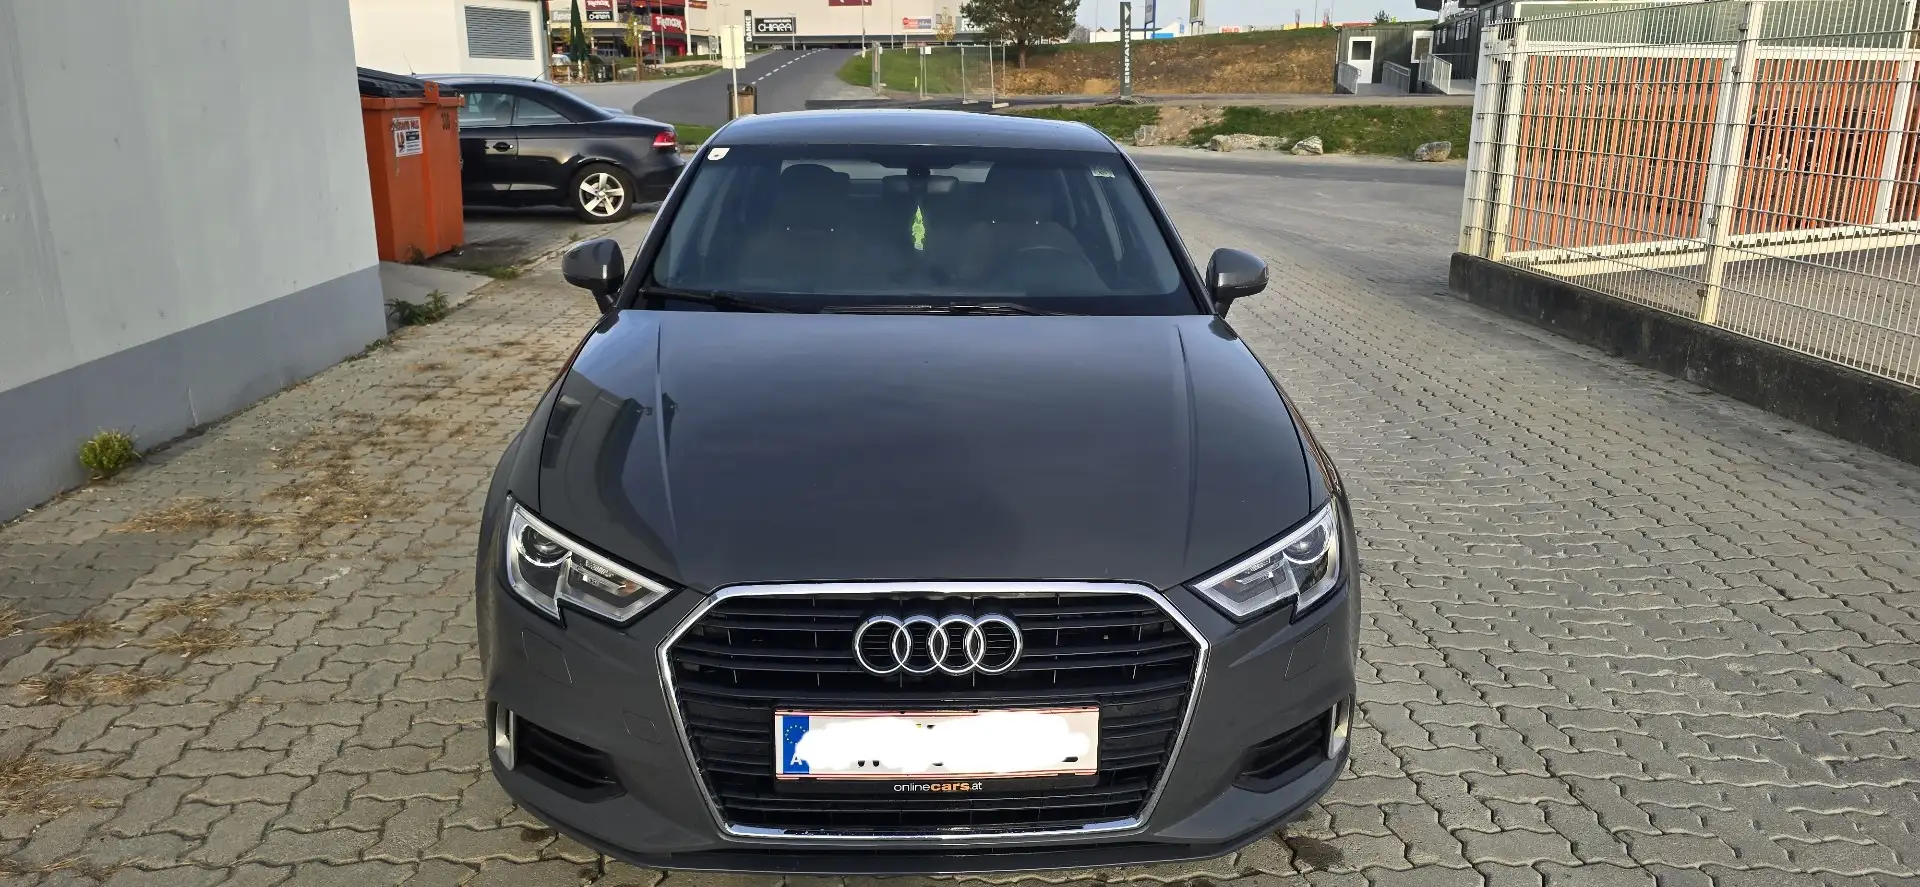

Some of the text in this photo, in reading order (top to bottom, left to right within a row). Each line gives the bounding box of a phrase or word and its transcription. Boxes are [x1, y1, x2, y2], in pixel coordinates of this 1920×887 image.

[745, 15, 753, 42] DANKE
[757, 23, 793, 32] CHIARA
[893, 781, 983, 792] onlinecars.at
